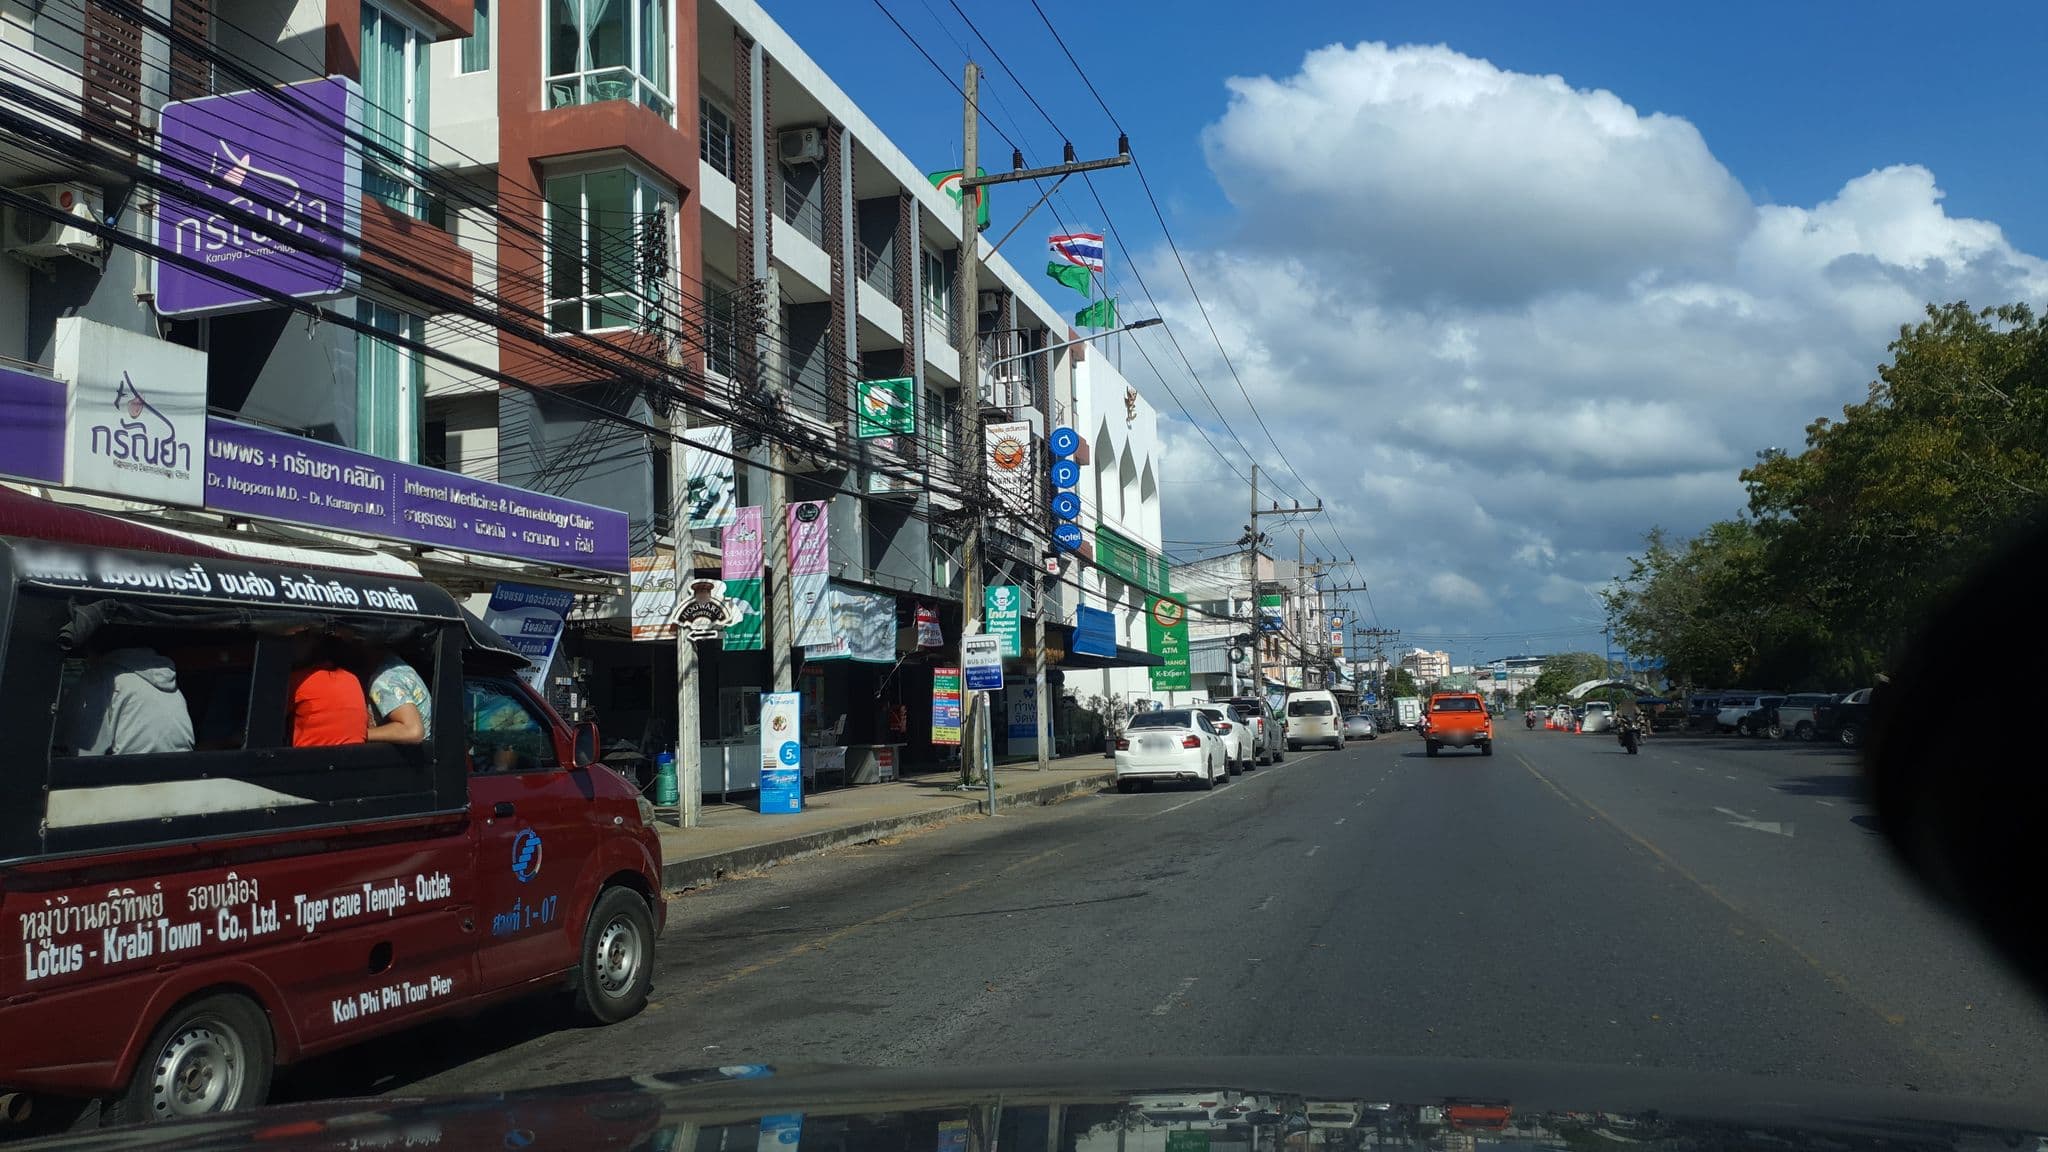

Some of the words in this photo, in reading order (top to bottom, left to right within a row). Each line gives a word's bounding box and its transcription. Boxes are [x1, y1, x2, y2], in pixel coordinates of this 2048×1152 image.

[206, 251, 243, 265] Karanya
[91, 418, 192, 473] กรัณยา
[209, 438, 264, 467] นพพร
[268, 453, 279, 469] +
[283, 451, 340, 482] กรัณยา
[344, 465, 385, 492] คลินิก
[208, 472, 225, 488] Dr.
[276, 486, 300, 502] M.D.
[310, 492, 324, 506] Dr.
[326, 495, 364, 516] Karanya
[365, 503, 387, 517] M.D.
[404, 478, 448, 501] Internal
[450, 488, 498, 513] Medicine
[499, 499, 508, 513] &
[509, 501, 568, 529] Dermatology
[569, 513, 594, 531] Clinic
[404, 509, 456, 530] อายุรกรรม
[1058, 532, 1081, 543] hotel
[218, 571, 276, 597] ขนส่ง
[279, 574, 359, 605] วัดถ้ำเสือ
[363, 586, 419, 612] เอาเล็ต
[682, 602, 724, 620] HOGWARTS
[966, 657, 979, 665] BUS
[1155, 669, 1186, 679] K-Expert
[187, 871, 258, 911] รอบเมือง
[25, 942, 83, 981] Lotus
[89, 949, 97, 958] -
[103, 920, 153, 965] Krabi
[157, 918, 201, 953] Town
[207, 928, 213, 936] -
[218, 906, 247, 943] Co.,
[252, 900, 281, 936] Ltd.
[285, 913, 291, 921] -
[294, 894, 329, 934] Tiger
[332, 892, 361, 920] cave
[363, 879, 406, 916] Temple
[416, 871, 451, 903] Outlet
[332, 998, 358, 1024] Koh
[360, 991, 379, 1017] Phi
[382, 984, 401, 1011] Phi
[403, 981, 428, 1004] Tour
[431, 974, 453, 997] Pier
